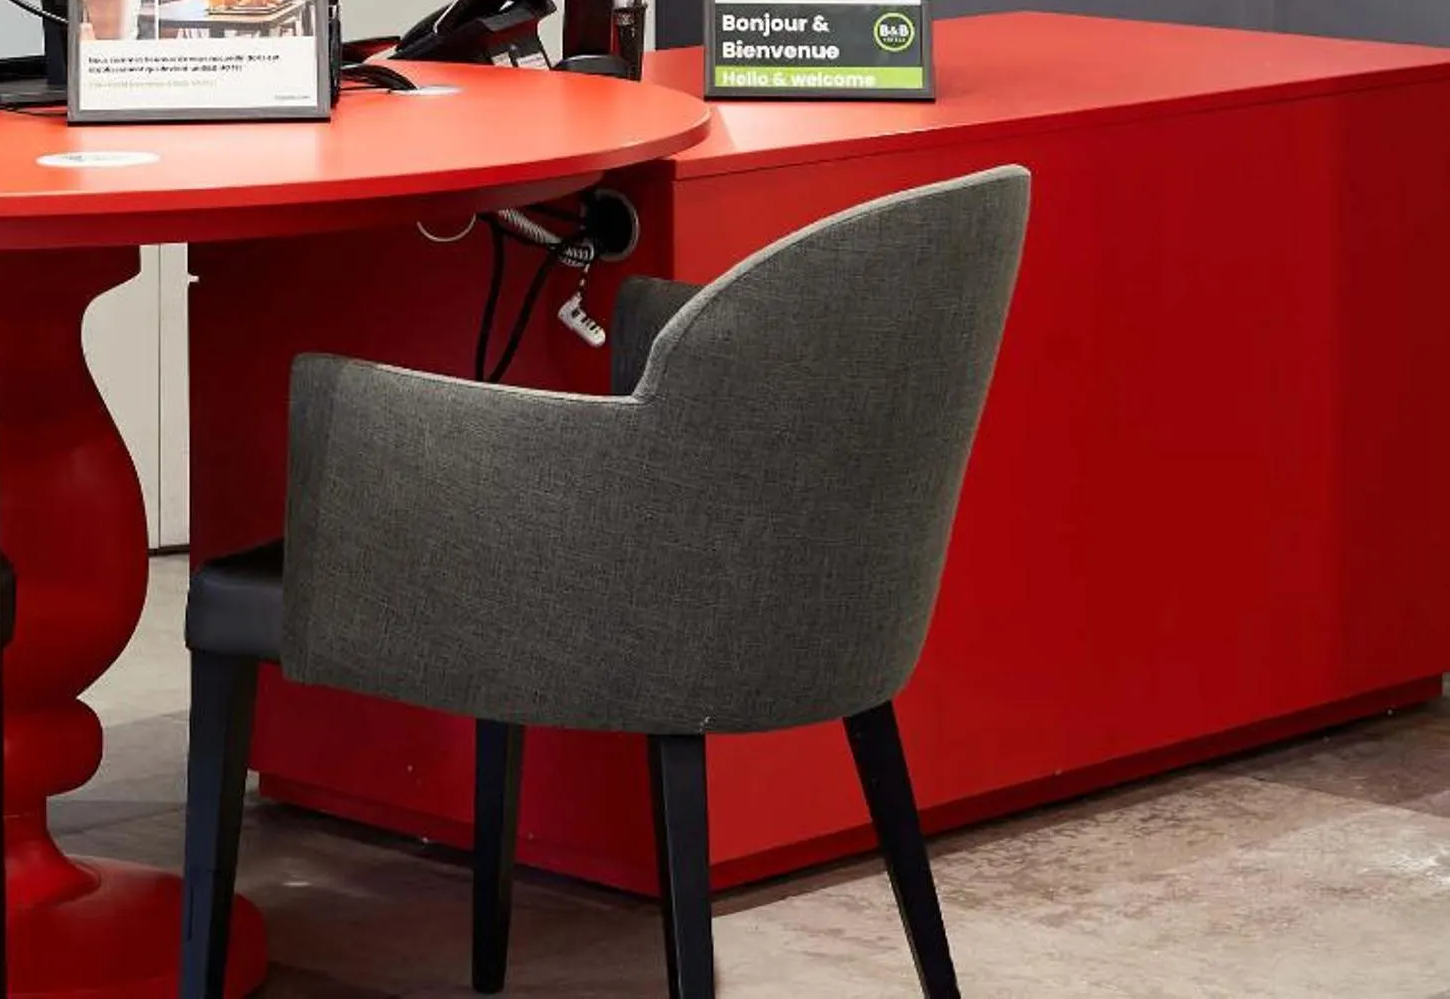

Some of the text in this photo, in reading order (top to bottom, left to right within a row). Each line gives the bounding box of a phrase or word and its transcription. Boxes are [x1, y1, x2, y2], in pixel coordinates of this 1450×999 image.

[722, 13, 830, 37] Bonjour &
[880, 24, 909, 37] B&B
[722, 40, 840, 60] Bienvenue
[722, 71, 877, 87] Hello & welcome
